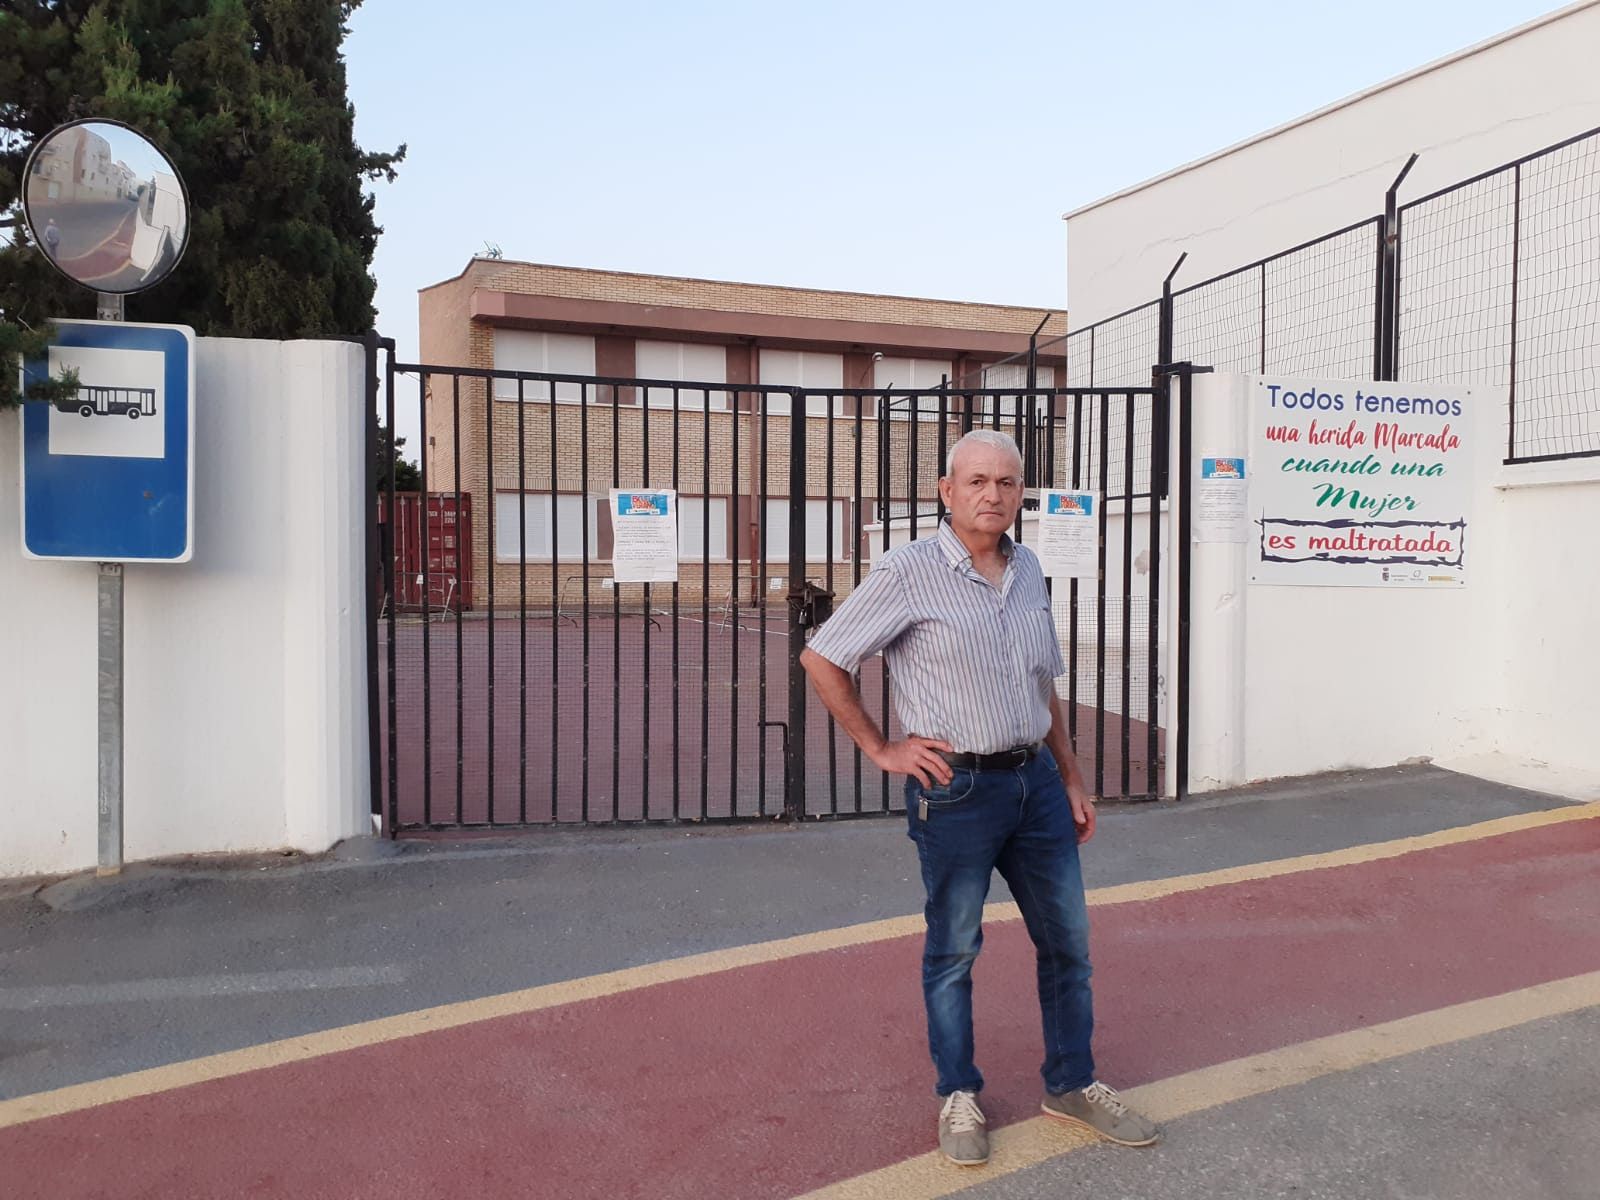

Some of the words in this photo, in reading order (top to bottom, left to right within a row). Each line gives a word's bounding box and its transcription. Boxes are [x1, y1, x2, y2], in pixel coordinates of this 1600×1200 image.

[1267, 385, 1344, 411] Todos
[1356, 390, 1461, 416] tenemos
[1266, 423, 1301, 443] una
[1309, 419, 1366, 449] herida
[1374, 422, 1461, 454] Marcada
[1281, 454, 1381, 475] cuando
[1391, 461, 1446, 477] una
[1312, 482, 1421, 518] Mujer
[1268, 534, 1296, 549] es
[1309, 529, 1454, 552] maltratada
